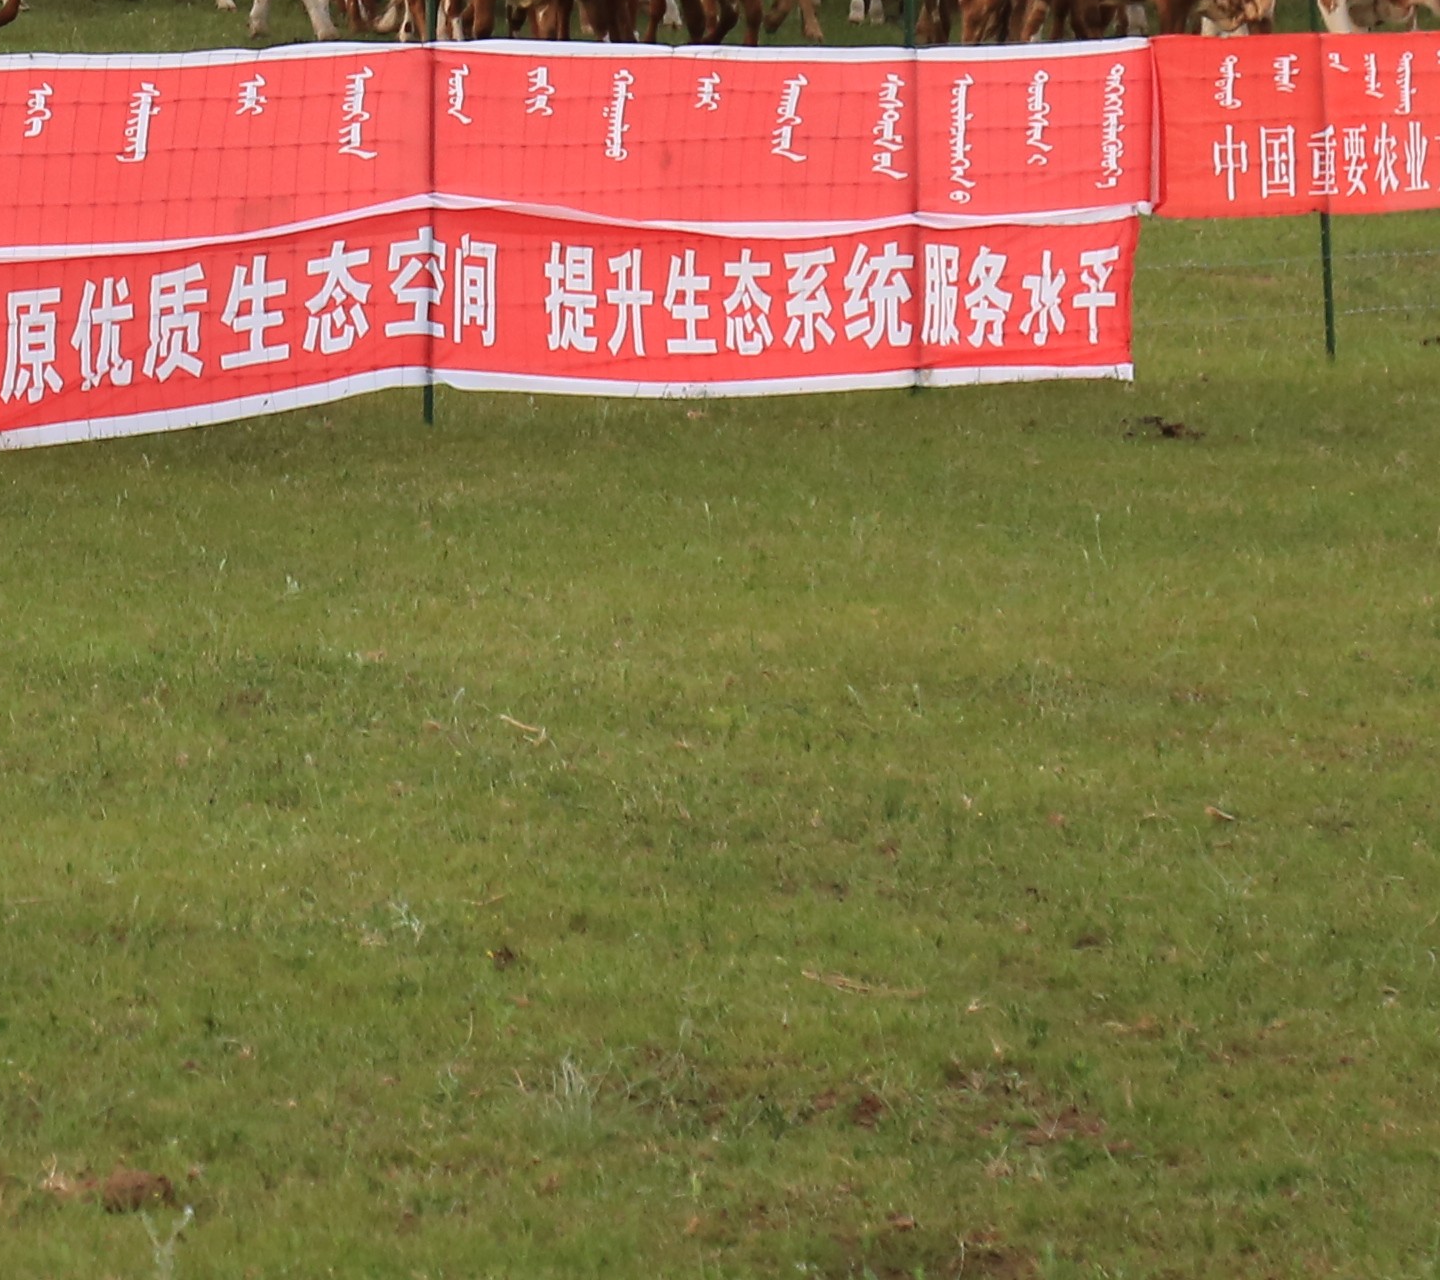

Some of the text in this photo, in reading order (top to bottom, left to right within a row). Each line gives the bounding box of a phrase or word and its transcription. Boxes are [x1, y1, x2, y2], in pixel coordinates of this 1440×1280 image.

[544, 240, 1119, 356] 提升生态系统服务水平
